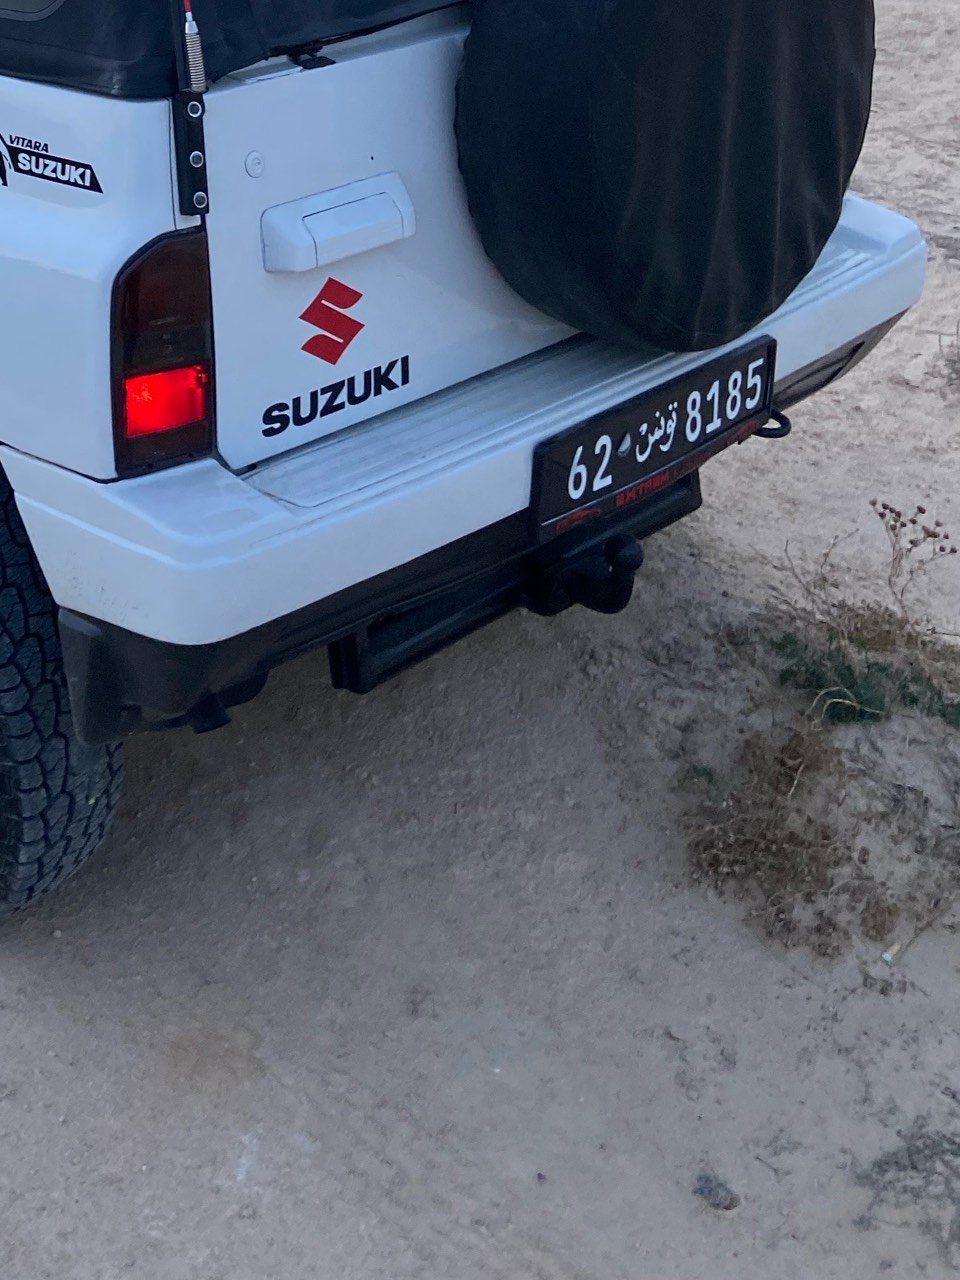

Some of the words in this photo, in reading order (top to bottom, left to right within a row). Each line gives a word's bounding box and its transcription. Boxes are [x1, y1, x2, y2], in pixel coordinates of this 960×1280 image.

[9, 134, 49, 154] VITARA
[17, 152, 92, 187] SUZUKI
[262, 354, 411, 438] SUZUKI
[567, 434, 614, 500] 62
[635, 401, 679, 463] تونس
[685, 358, 765, 443] 8185
